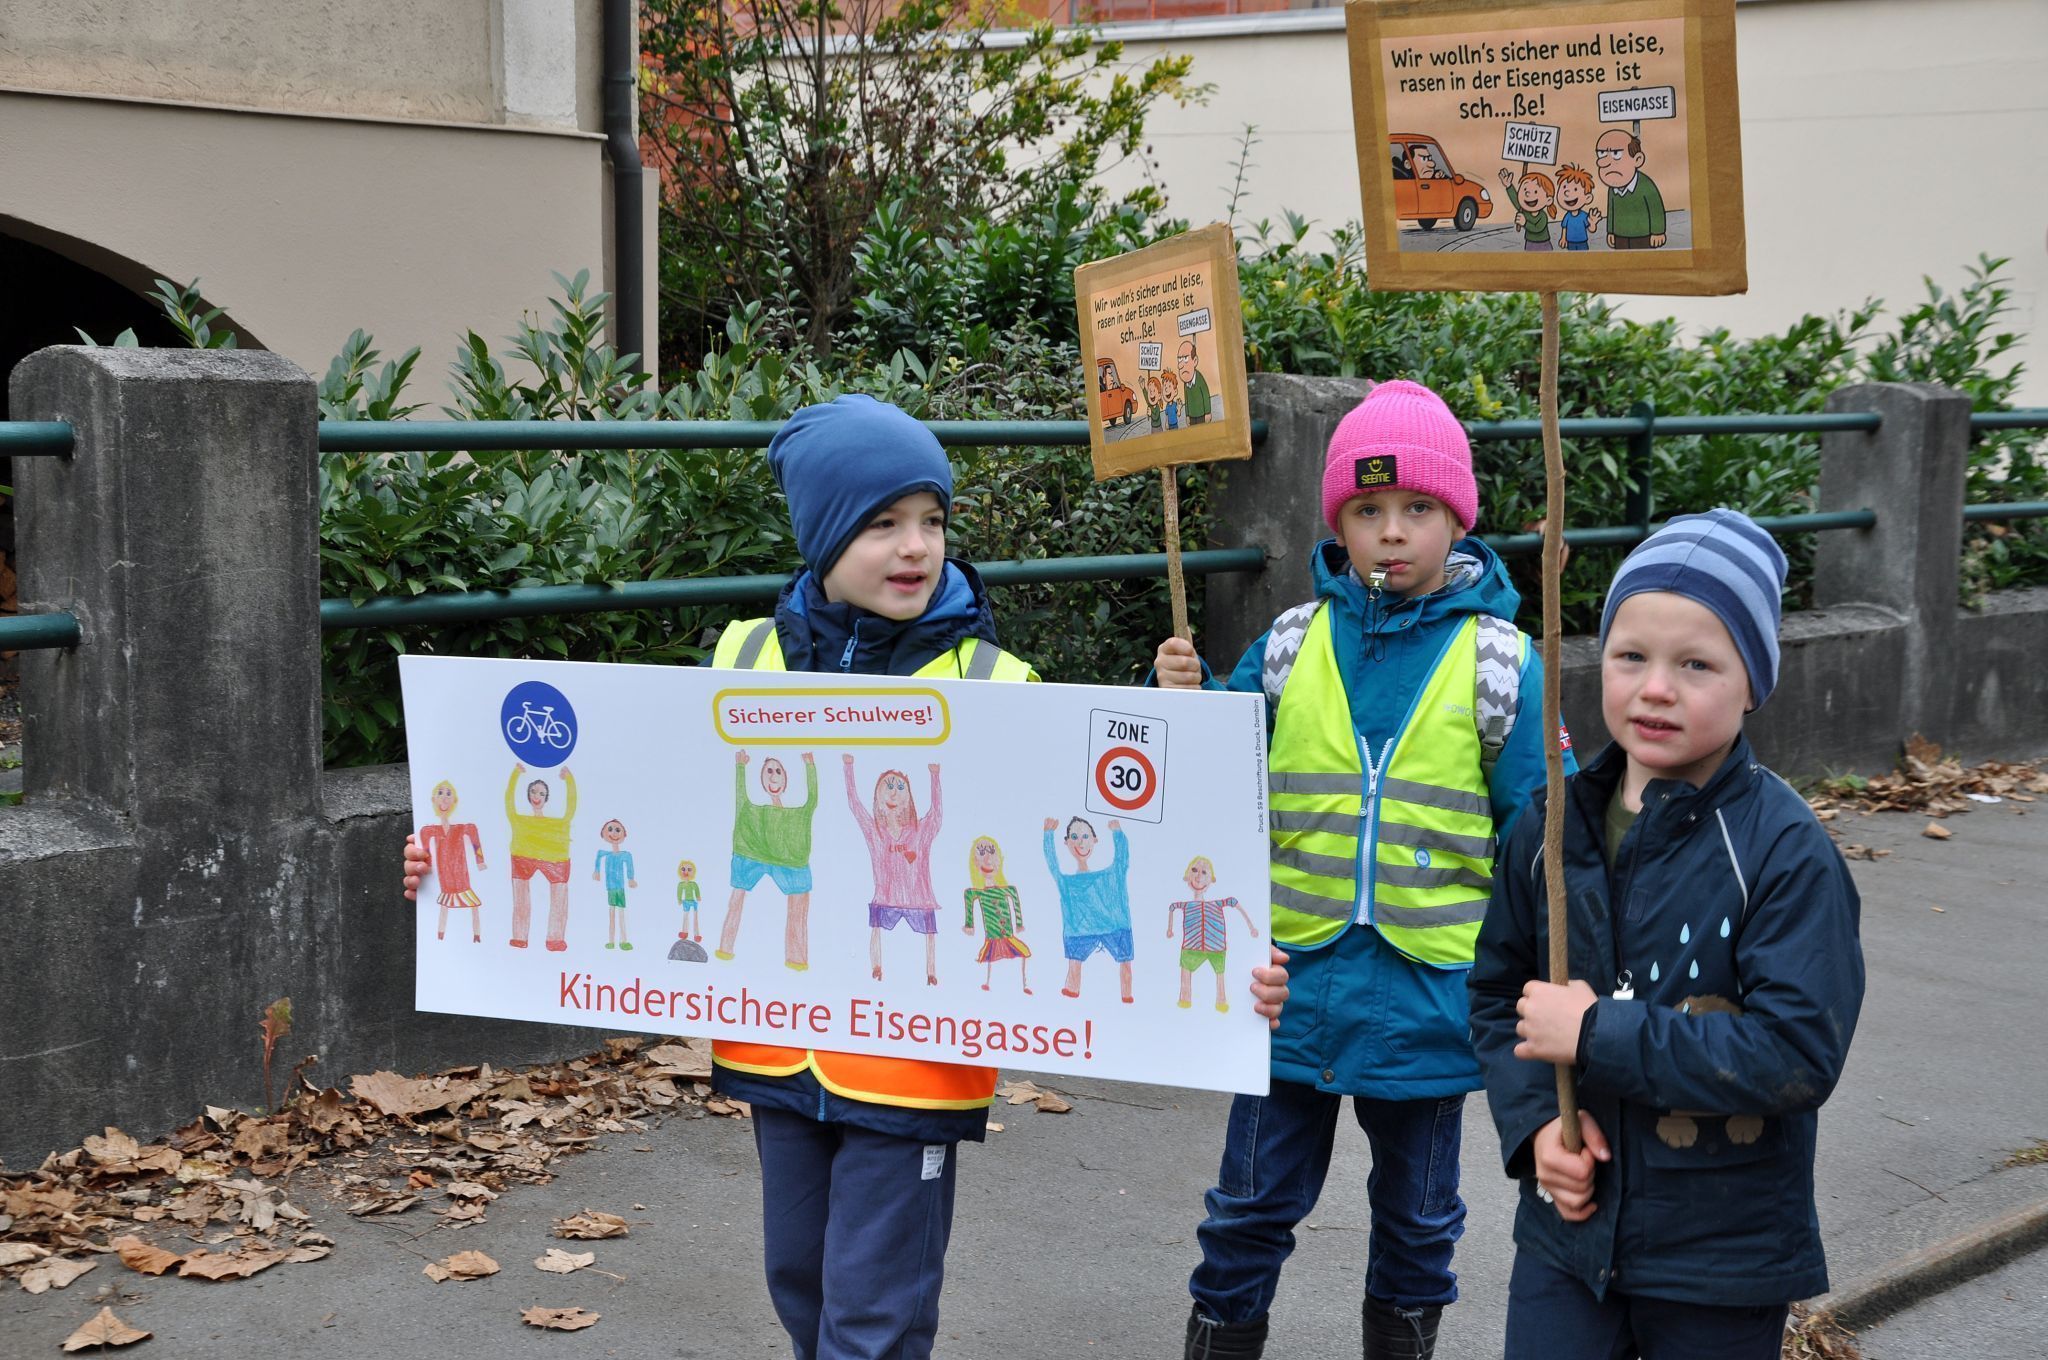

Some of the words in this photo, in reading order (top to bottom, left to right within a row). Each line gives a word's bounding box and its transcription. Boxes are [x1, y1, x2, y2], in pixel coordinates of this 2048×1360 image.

[1391, 48, 1423, 69] Wir
[1430, 42, 1495, 66] wolln's
[1500, 40, 1559, 62] sicher
[1566, 34, 1601, 57] und
[1609, 32, 1665, 56] leise,
[1400, 76, 1446, 93] rasen
[1450, 72, 1466, 91] in
[1472, 70, 1501, 90] der
[1506, 66, 1606, 90] Eisengasse
[1615, 61, 1641, 82] ist
[1602, 94, 1669, 115] EISENGASSE
[1508, 127, 1552, 144] SCHÜTZ
[1507, 143, 1549, 160] KINDER
[1094, 297, 1108, 313] Wir
[1136, 284, 1160, 300] sicher
[1162, 275, 1177, 292] und
[1180, 273, 1203, 289] leise,
[1097, 318, 1115, 330] rasen
[1116, 311, 1123, 324] in
[1125, 308, 1136, 322] der
[1138, 298, 1180, 317] Eisengasse
[1183, 292, 1195, 307] ist
[1179, 314, 1208, 331] EISENGASSE
[1140, 345, 1159, 356] SCHÜTZ
[1140, 357, 1158, 367] KINDER
[728, 708, 816, 724] Sicherer
[824, 705, 934, 726] Schulweg!
[1106, 719, 1150, 744] ZONE
[1110, 765, 1142, 791] 30
[560, 972, 831, 1034] Kindersichere
[850, 999, 1093, 1060] Eisengasse!
